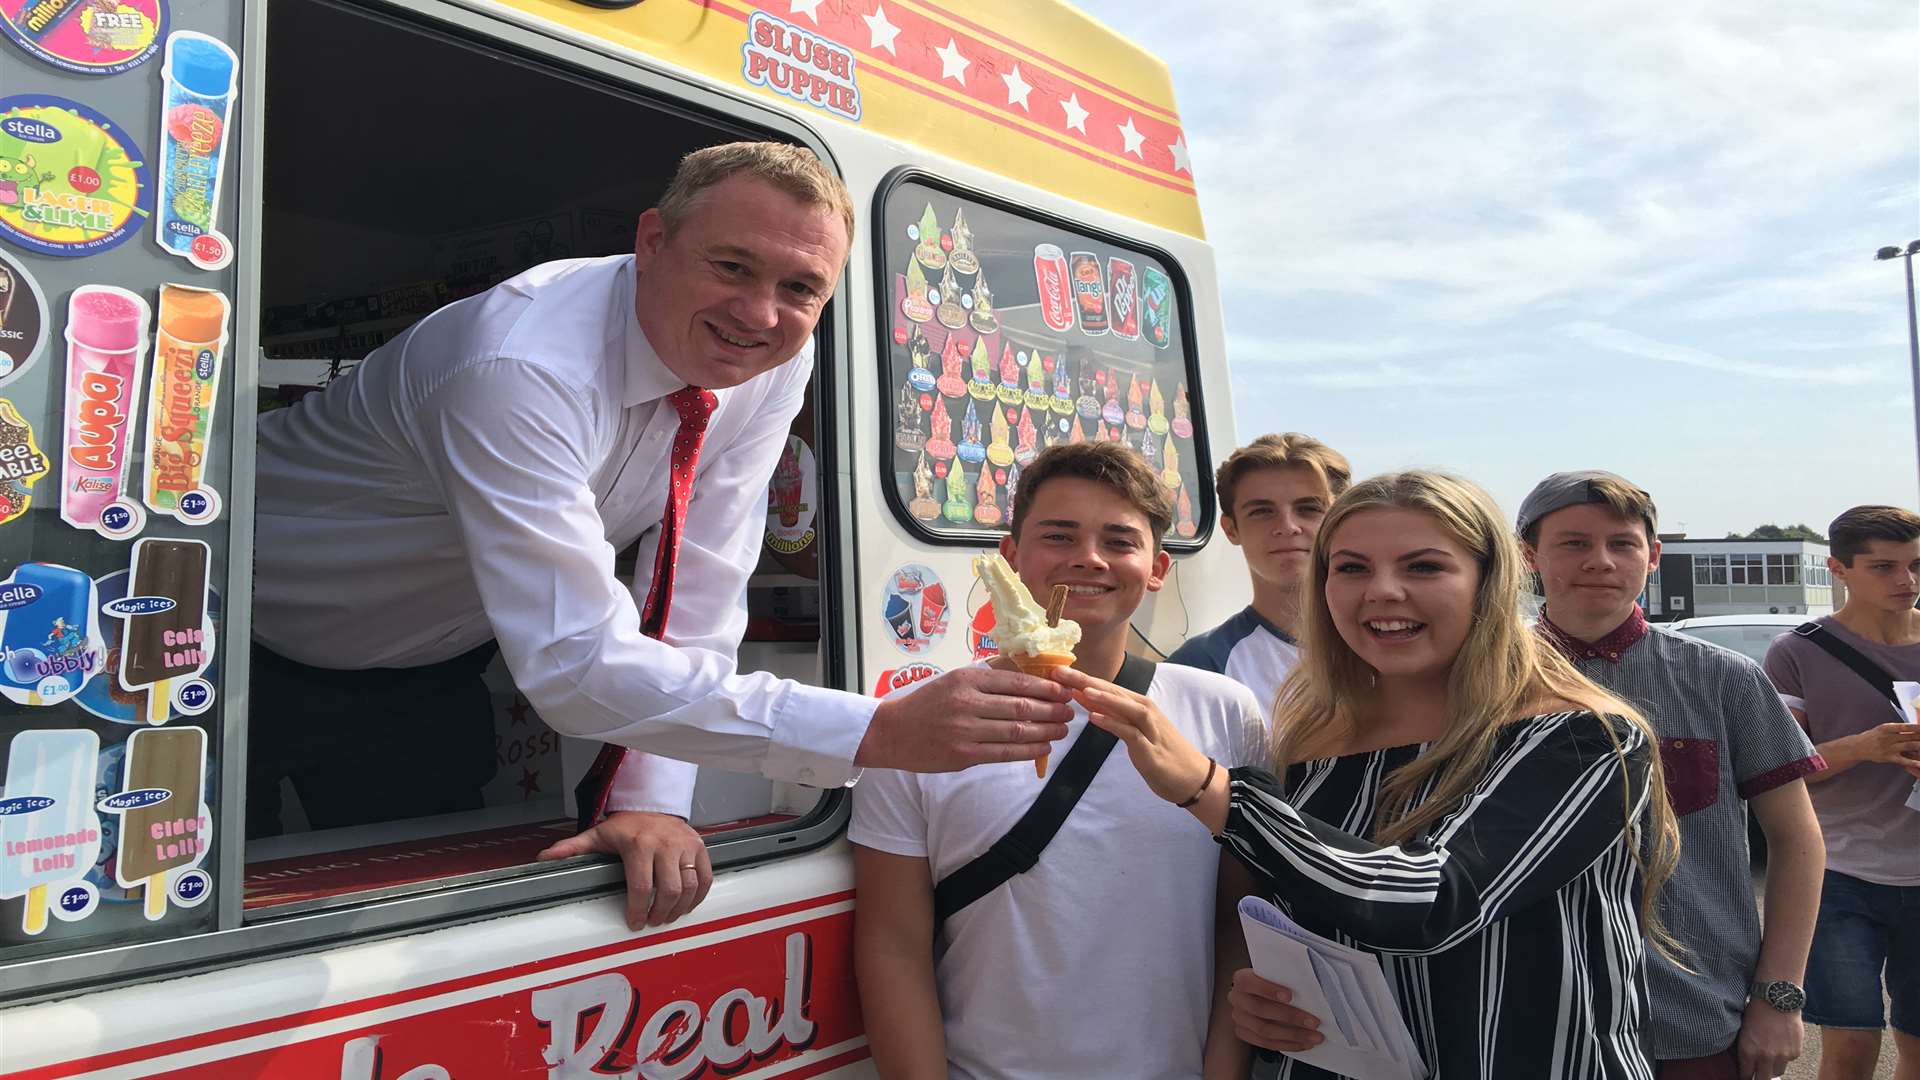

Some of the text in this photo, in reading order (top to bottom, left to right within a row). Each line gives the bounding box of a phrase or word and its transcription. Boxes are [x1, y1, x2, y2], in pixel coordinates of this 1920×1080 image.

[28, 0, 68, 32] millio
[95, 12, 142, 28] FREE
[755, 18, 850, 80] SLUSH
[747, 49, 857, 115] PUPPIE
[8, 121, 56, 139] stella
[70, 174, 100, 187] £1.00
[171, 221, 200, 235] stella
[194, 242, 221, 256] £1.50
[199, 352, 211, 377] stella
[156, 446, 200, 491] Big
[73, 475, 113, 492] Kalise
[183, 499, 206, 509] £1.50
[105, 512, 128, 524] £1.50
[767, 530, 814, 552] millions
[114, 599, 172, 613] Magic ices
[163, 629, 204, 647] Cola
[163, 650, 207, 669] Lolly
[892, 666, 944, 690] SLUS
[42, 683, 69, 696] £1.00
[181, 690, 207, 701] £1.00
[26, 799, 52, 808] ices
[109, 790, 168, 808] Magic ices
[151, 816, 206, 840] Cider
[6, 829, 98, 857] Lemonade
[156, 839, 205, 861] Lolly
[33, 853, 75, 873] Lolly
[179, 880, 204, 893] £1.00
[61, 893, 89, 906] £1.00
[531, 932, 815, 1080] Real
